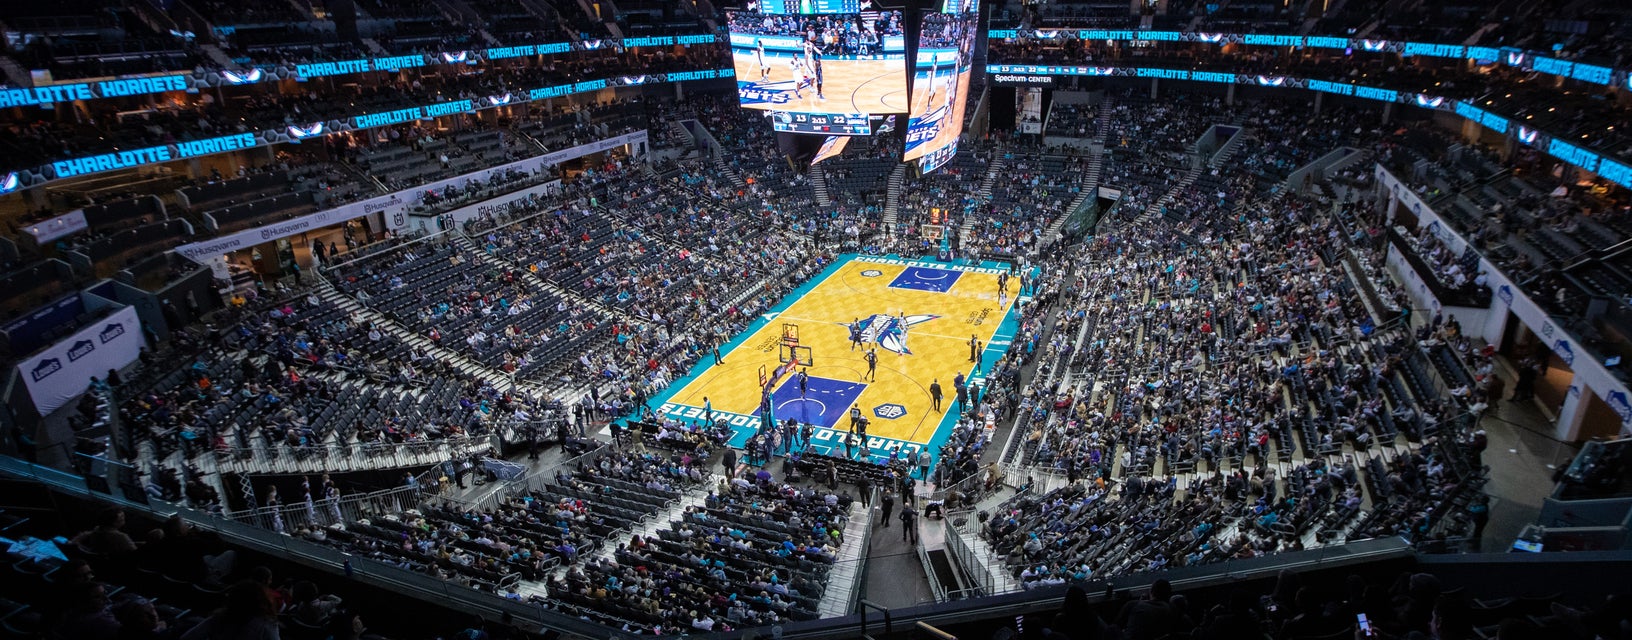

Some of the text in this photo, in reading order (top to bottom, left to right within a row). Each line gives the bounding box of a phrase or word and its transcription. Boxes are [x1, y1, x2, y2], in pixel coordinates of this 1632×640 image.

[624, 34, 715, 47] CHARLOTTE HORNETS
[988, 29, 1016, 38] RNETS
[1080, 30, 1179, 41] CHARLOTTE HORNETS
[1245, 34, 1348, 49] CHARLOTTE HORNETS
[488, 42, 570, 59] CHARLOTTE HORNETS
[1405, 42, 1462, 58] CHARLOTTE
[297, 55, 424, 78] CHARLOTTE HORNETS
[667, 70, 714, 82] CHARLOTTE
[995, 74, 1026, 83] Spectrum
[1137, 68, 1235, 83] CHARLOTTE HORNETS
[0, 75, 187, 108] ARLOTTE HORNETS
[530, 79, 606, 100] CHARLOTTE HORNETS
[1308, 79, 1398, 102] CHARLOTTE HORNETS
[355, 100, 471, 129] CHARLOTTE HORNETS
[54, 133, 256, 177] CHARLOTTE HORNETS
[270, 220, 309, 236] Husqvarna
[195, 239, 240, 256] Husqvarna
